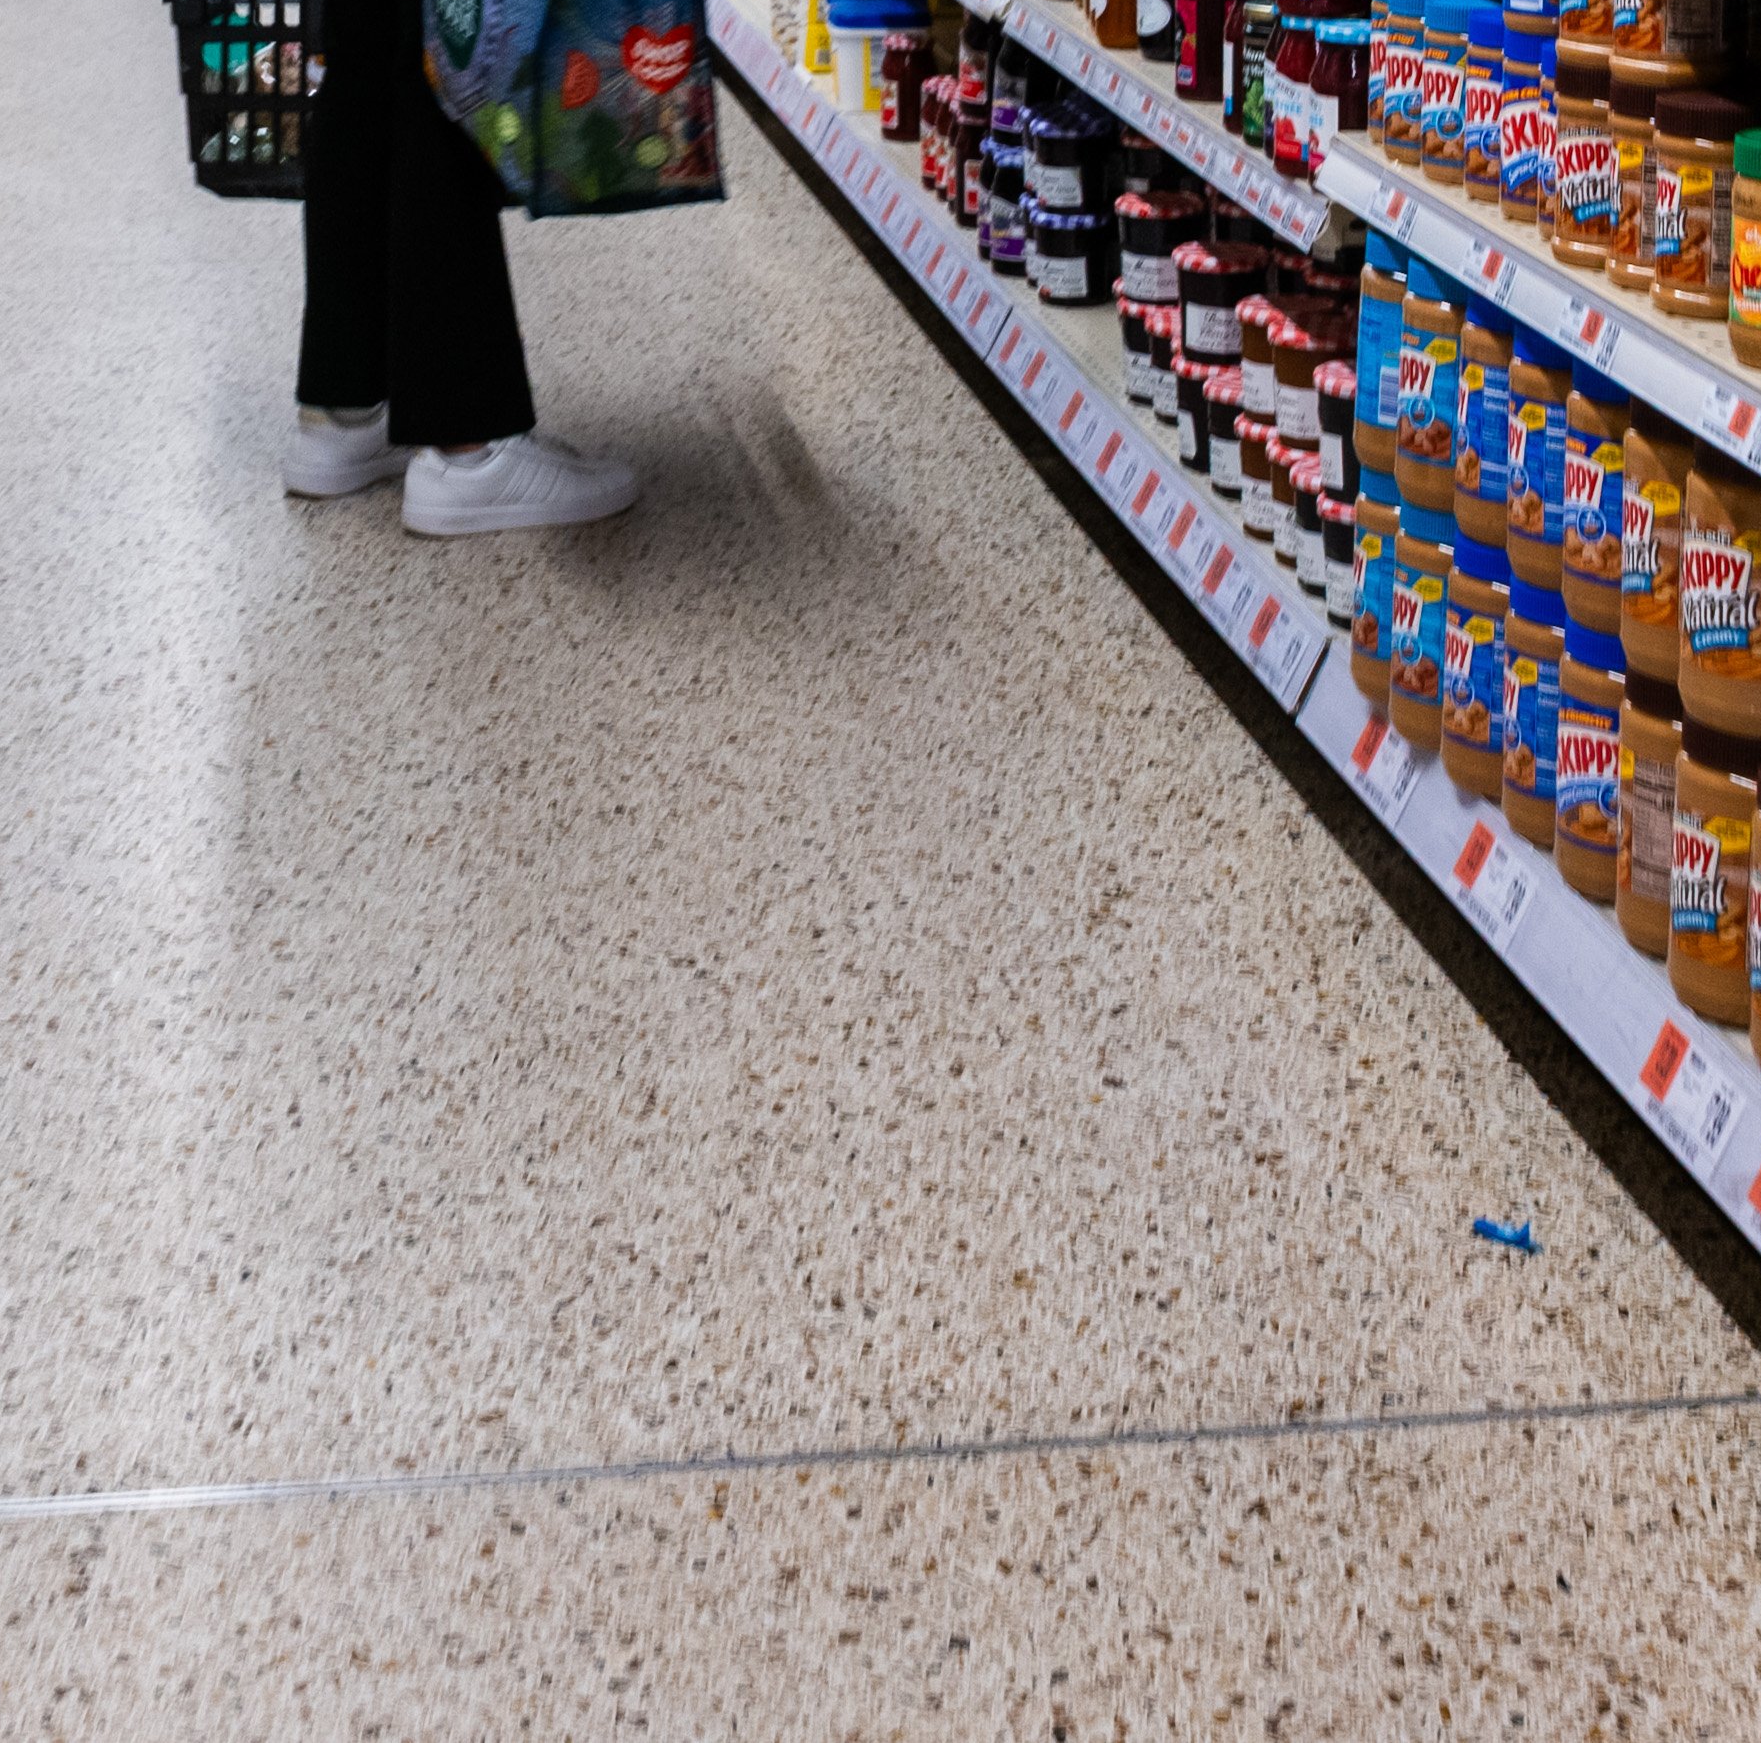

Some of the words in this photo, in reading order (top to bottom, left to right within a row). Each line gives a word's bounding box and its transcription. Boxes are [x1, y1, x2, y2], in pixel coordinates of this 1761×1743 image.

[1386, 54, 1424, 88] IPPY
[1423, 70, 1460, 104] IPPY
[1466, 87, 1504, 123] IPPY
[1501, 111, 1540, 157] SKI
[1557, 141, 1611, 180] SKIPP
[1400, 356, 1431, 391] PPY
[1565, 462, 1600, 503] IPPY
[1623, 500, 1649, 540] PPY
[1393, 595, 1419, 638] PPY
[1682, 589, 1760, 633] Natural
[1673, 832, 1715, 875] IPPY
